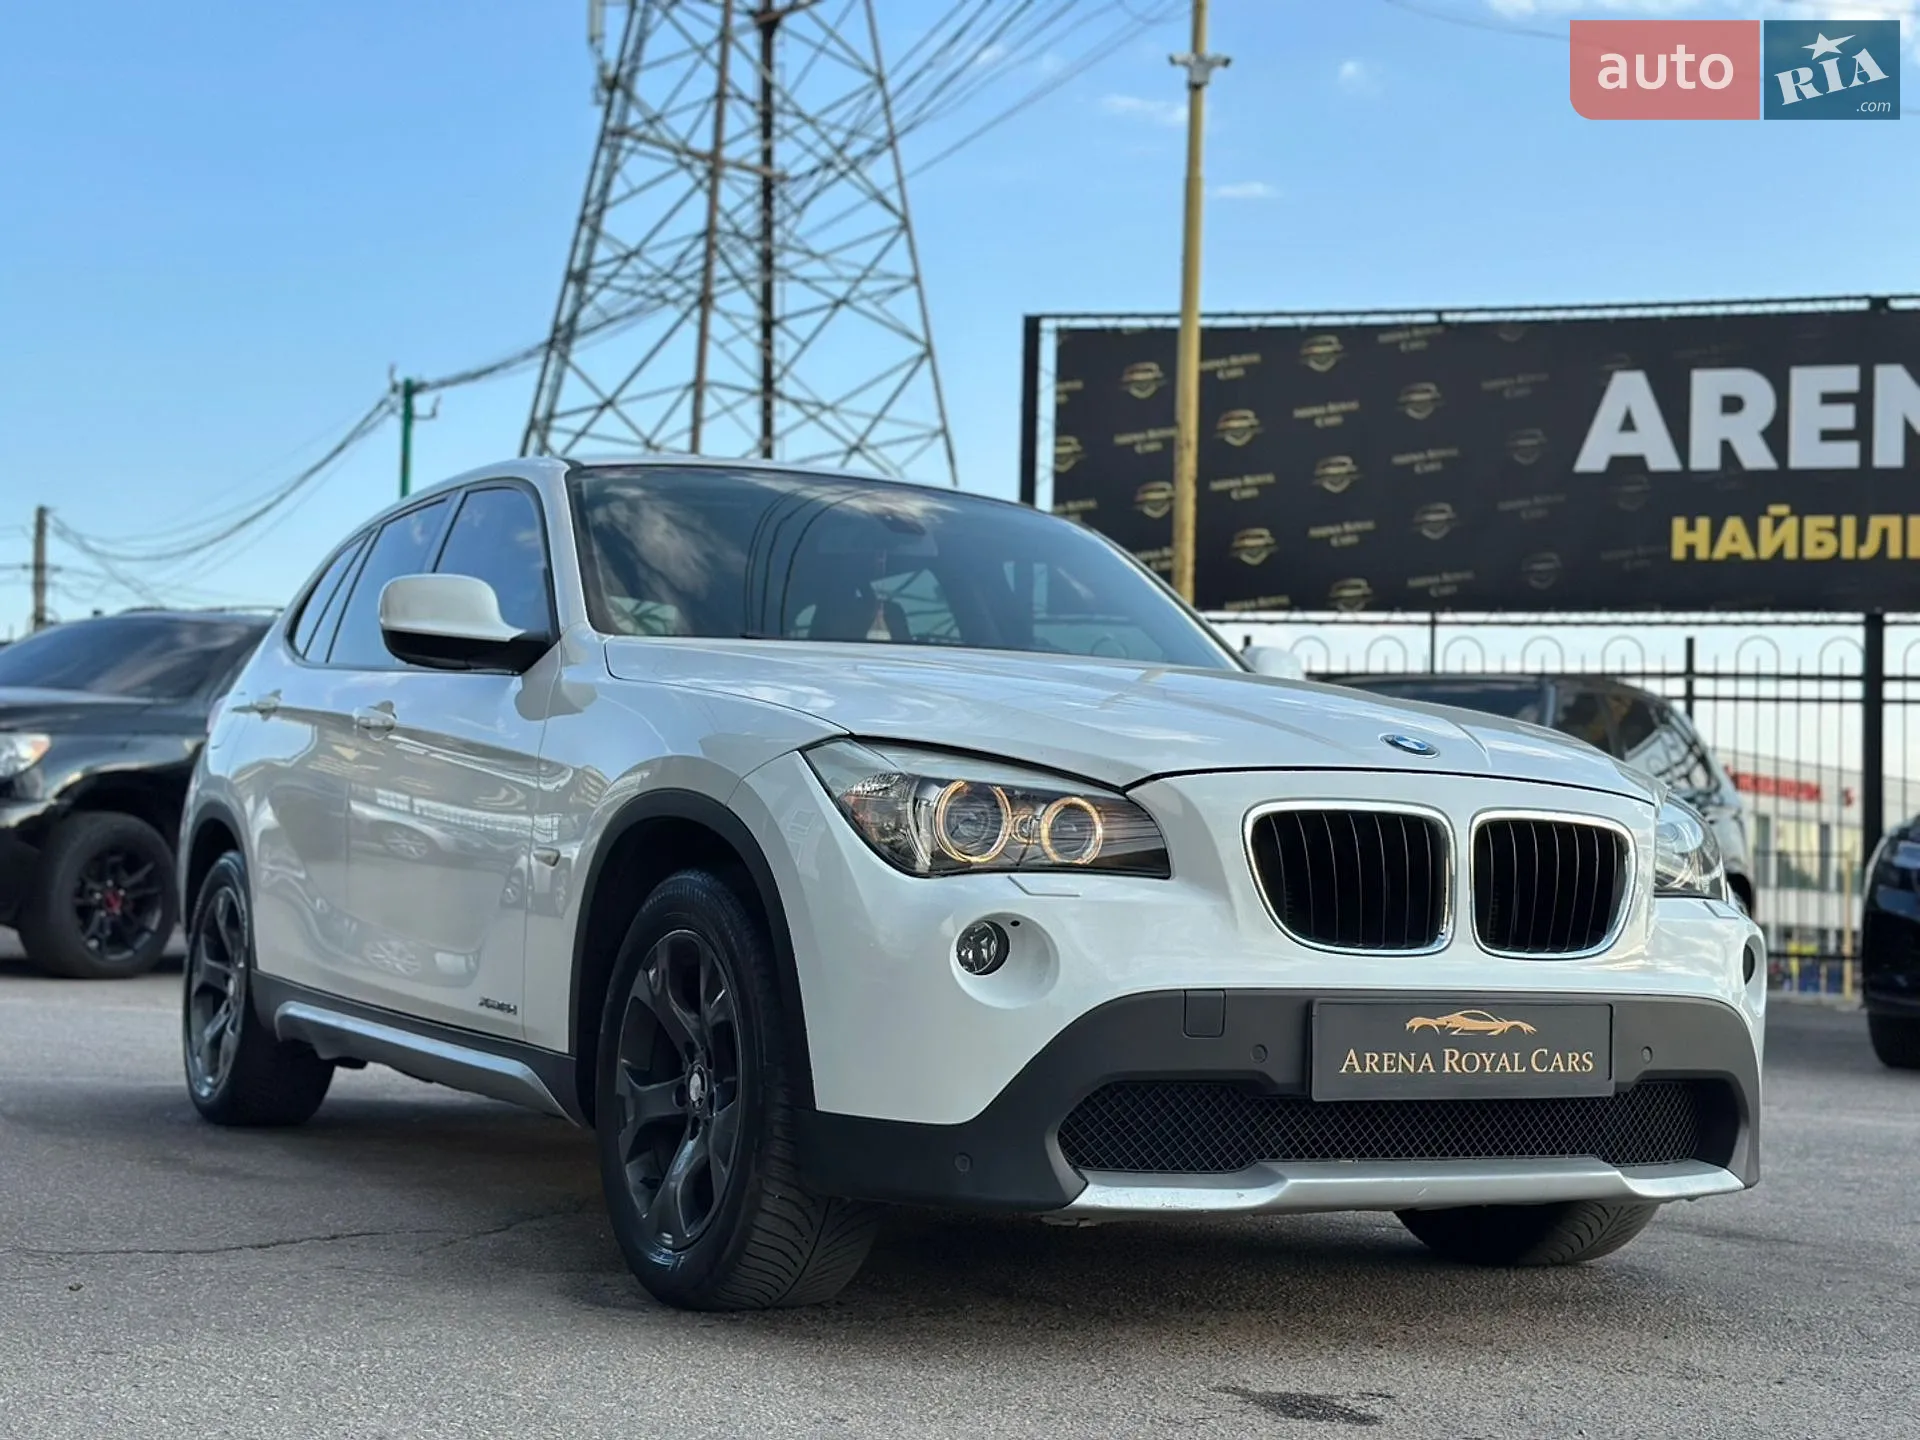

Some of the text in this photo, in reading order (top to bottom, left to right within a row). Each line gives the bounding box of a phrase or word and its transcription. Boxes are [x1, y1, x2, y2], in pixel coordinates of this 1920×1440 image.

[1339, 1048, 1594, 1074] ARENA ROYAL CARS
